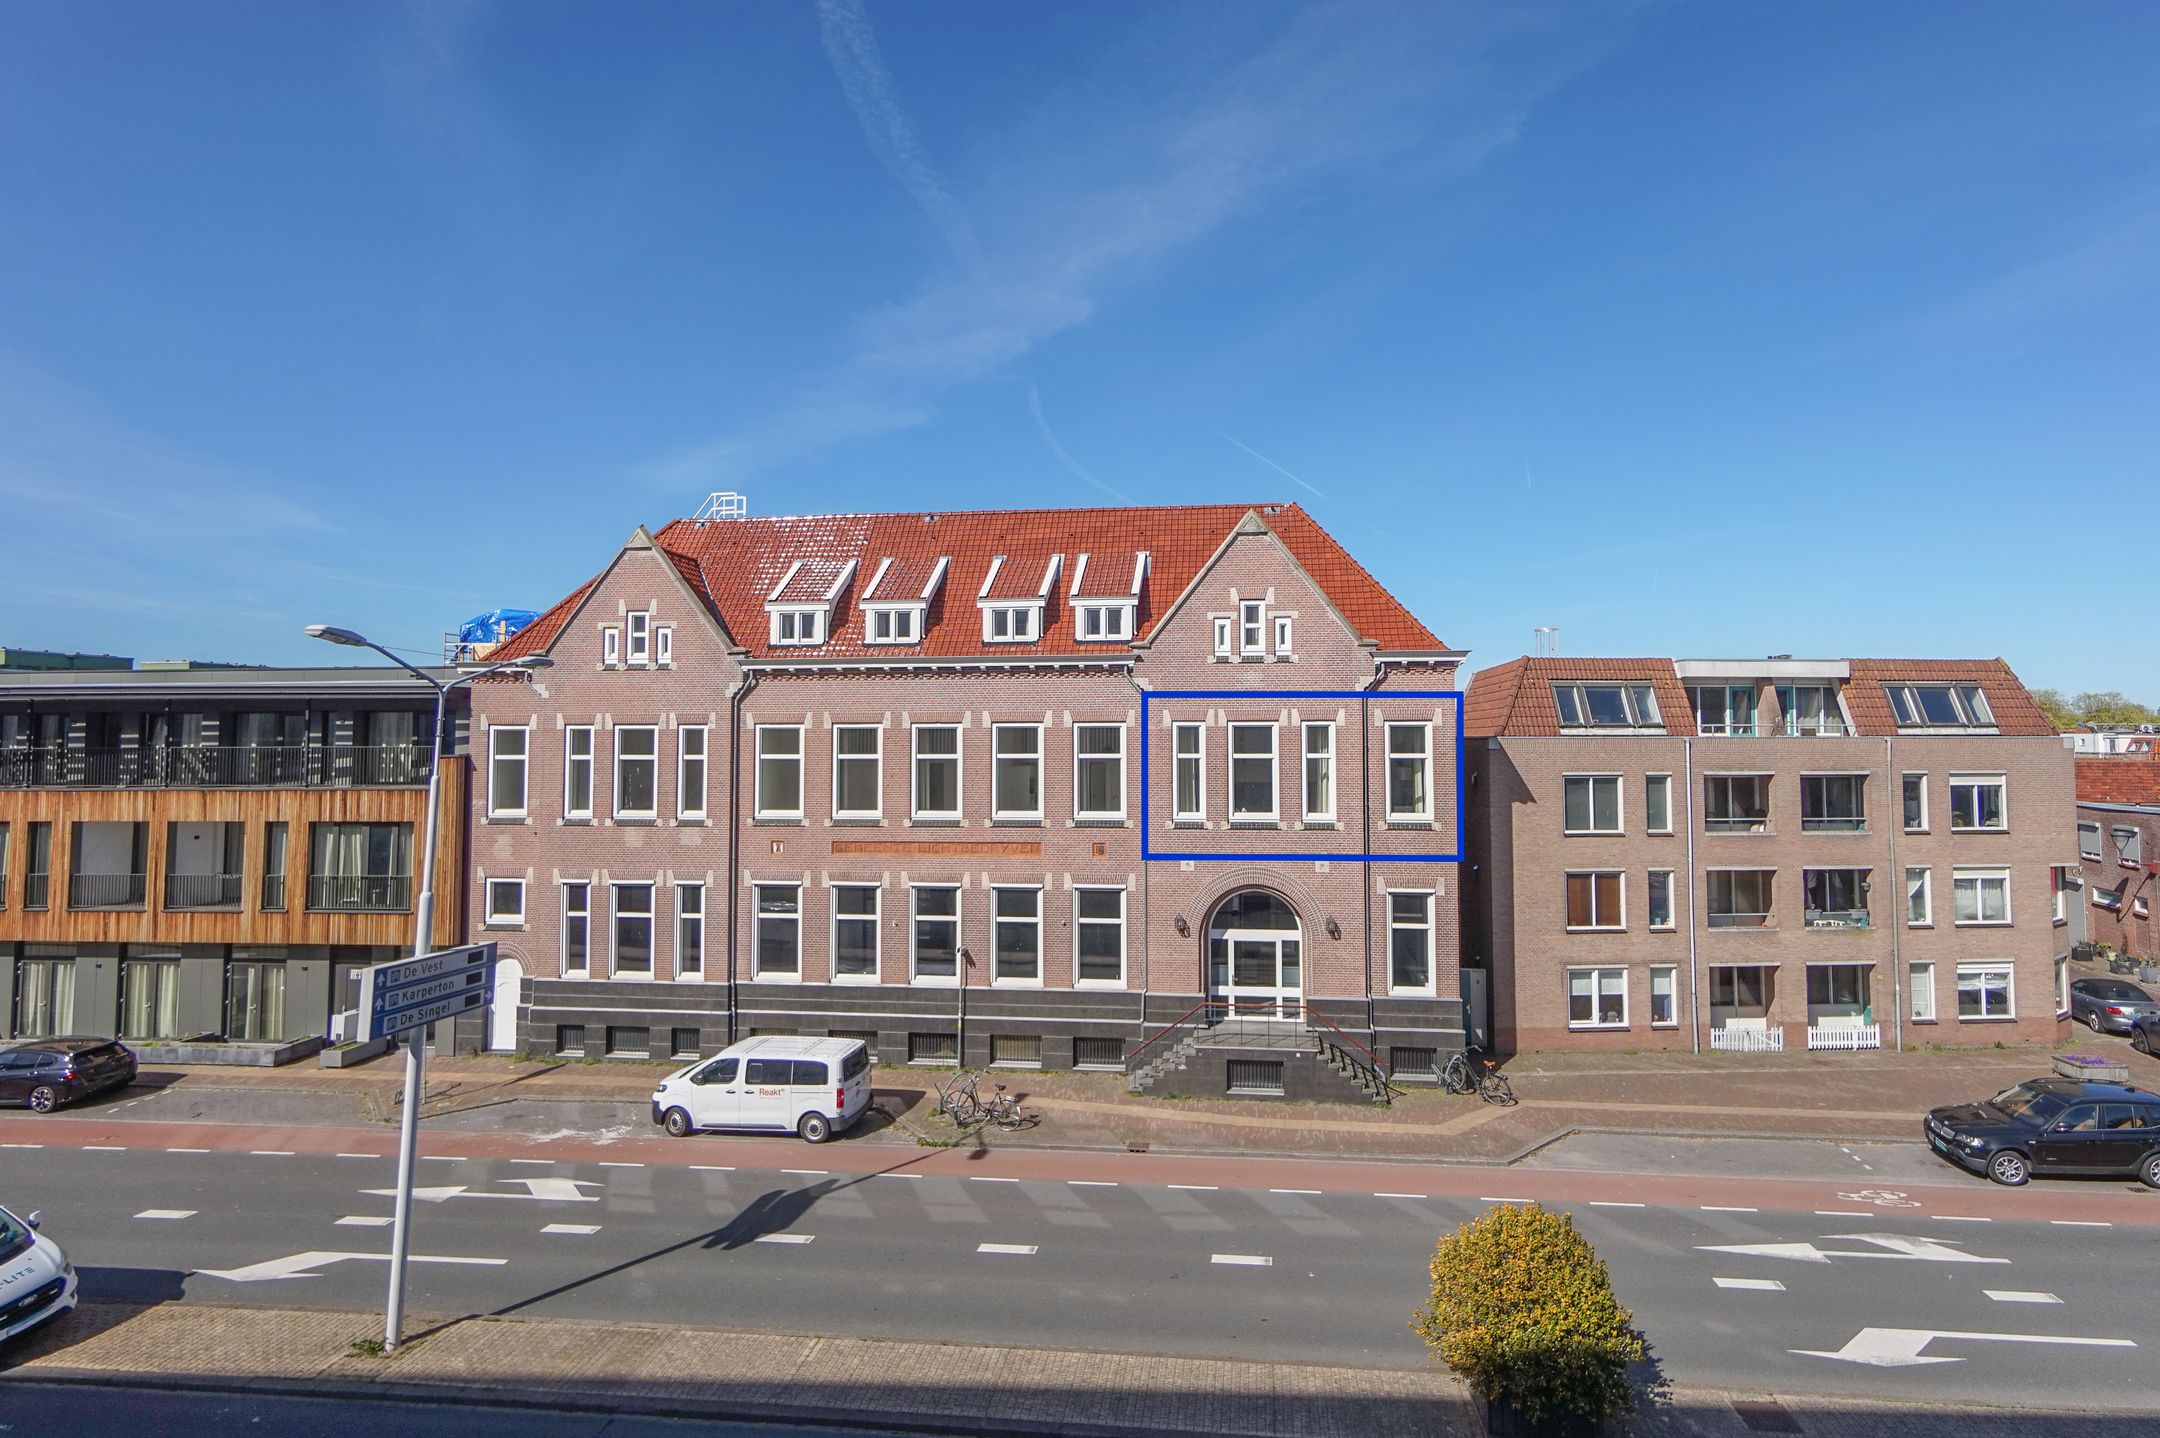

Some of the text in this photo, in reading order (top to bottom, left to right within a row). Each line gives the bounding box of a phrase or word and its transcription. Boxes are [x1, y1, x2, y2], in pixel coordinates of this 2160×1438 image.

[403, 960, 443, 979] De Vest
[402, 980, 454, 1002] Karperton
[400, 1002, 450, 1026] De Singel
[0, 1266, 35, 1290] -LITE
